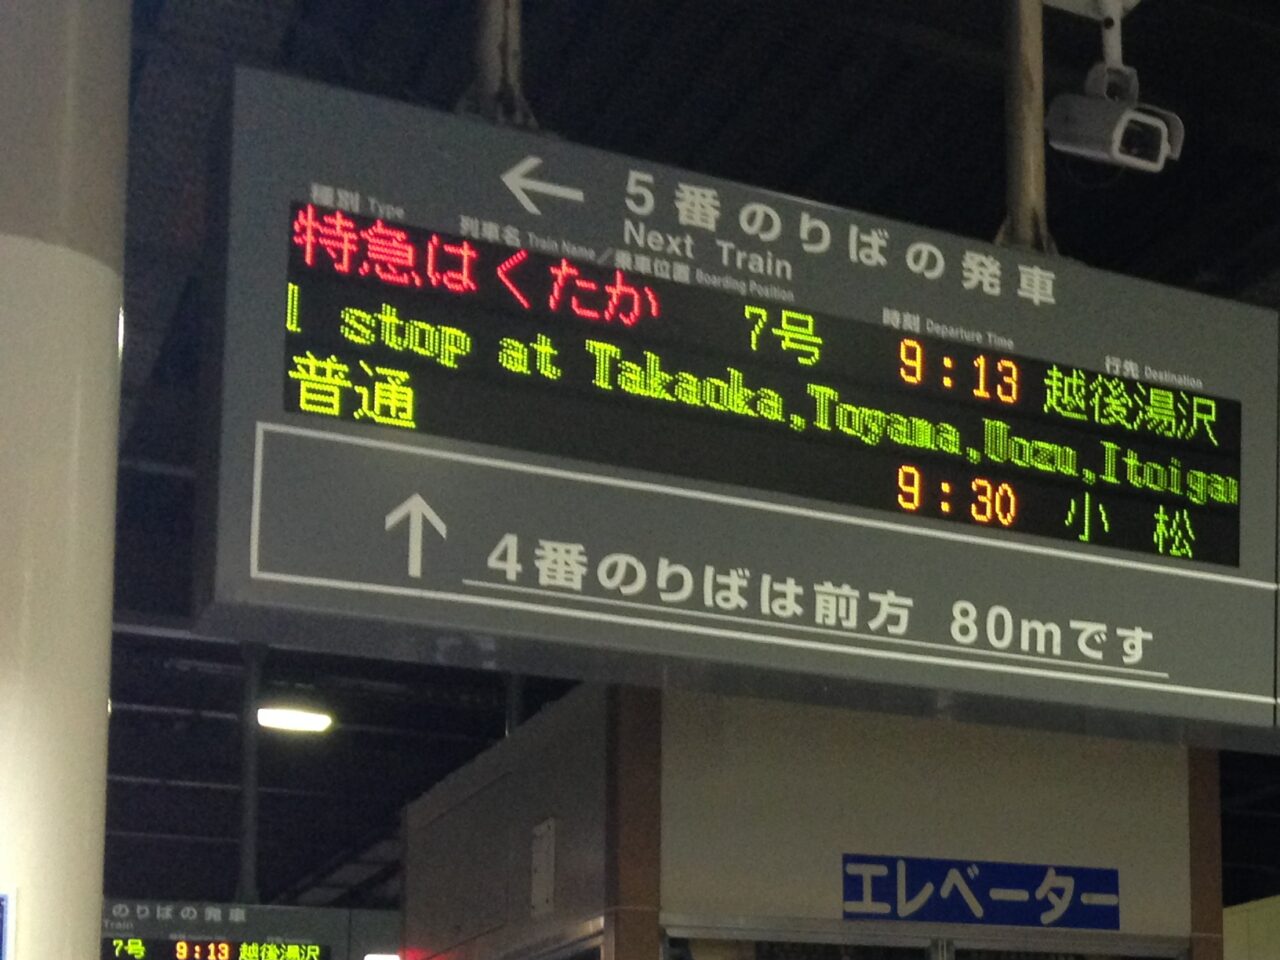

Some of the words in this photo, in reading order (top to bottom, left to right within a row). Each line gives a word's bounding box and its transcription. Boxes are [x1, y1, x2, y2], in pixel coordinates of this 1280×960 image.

[623, 219, 695, 259] Next
[715, 239, 793, 280] Train
[624, 169, 1057, 307] 5番のりばの発車
[340, 302, 473, 368] stop
[499, 333, 562, 380] at
[289, 350, 416, 429] 普通
[1043, 364, 1220, 447] 越後湯沢
[897, 464, 1017, 527] 9:30
[487, 533, 915, 635] 4番のりばは前方
[949, 600, 1154, 664] 80mです
[843, 859, 1119, 925] エレベーター
